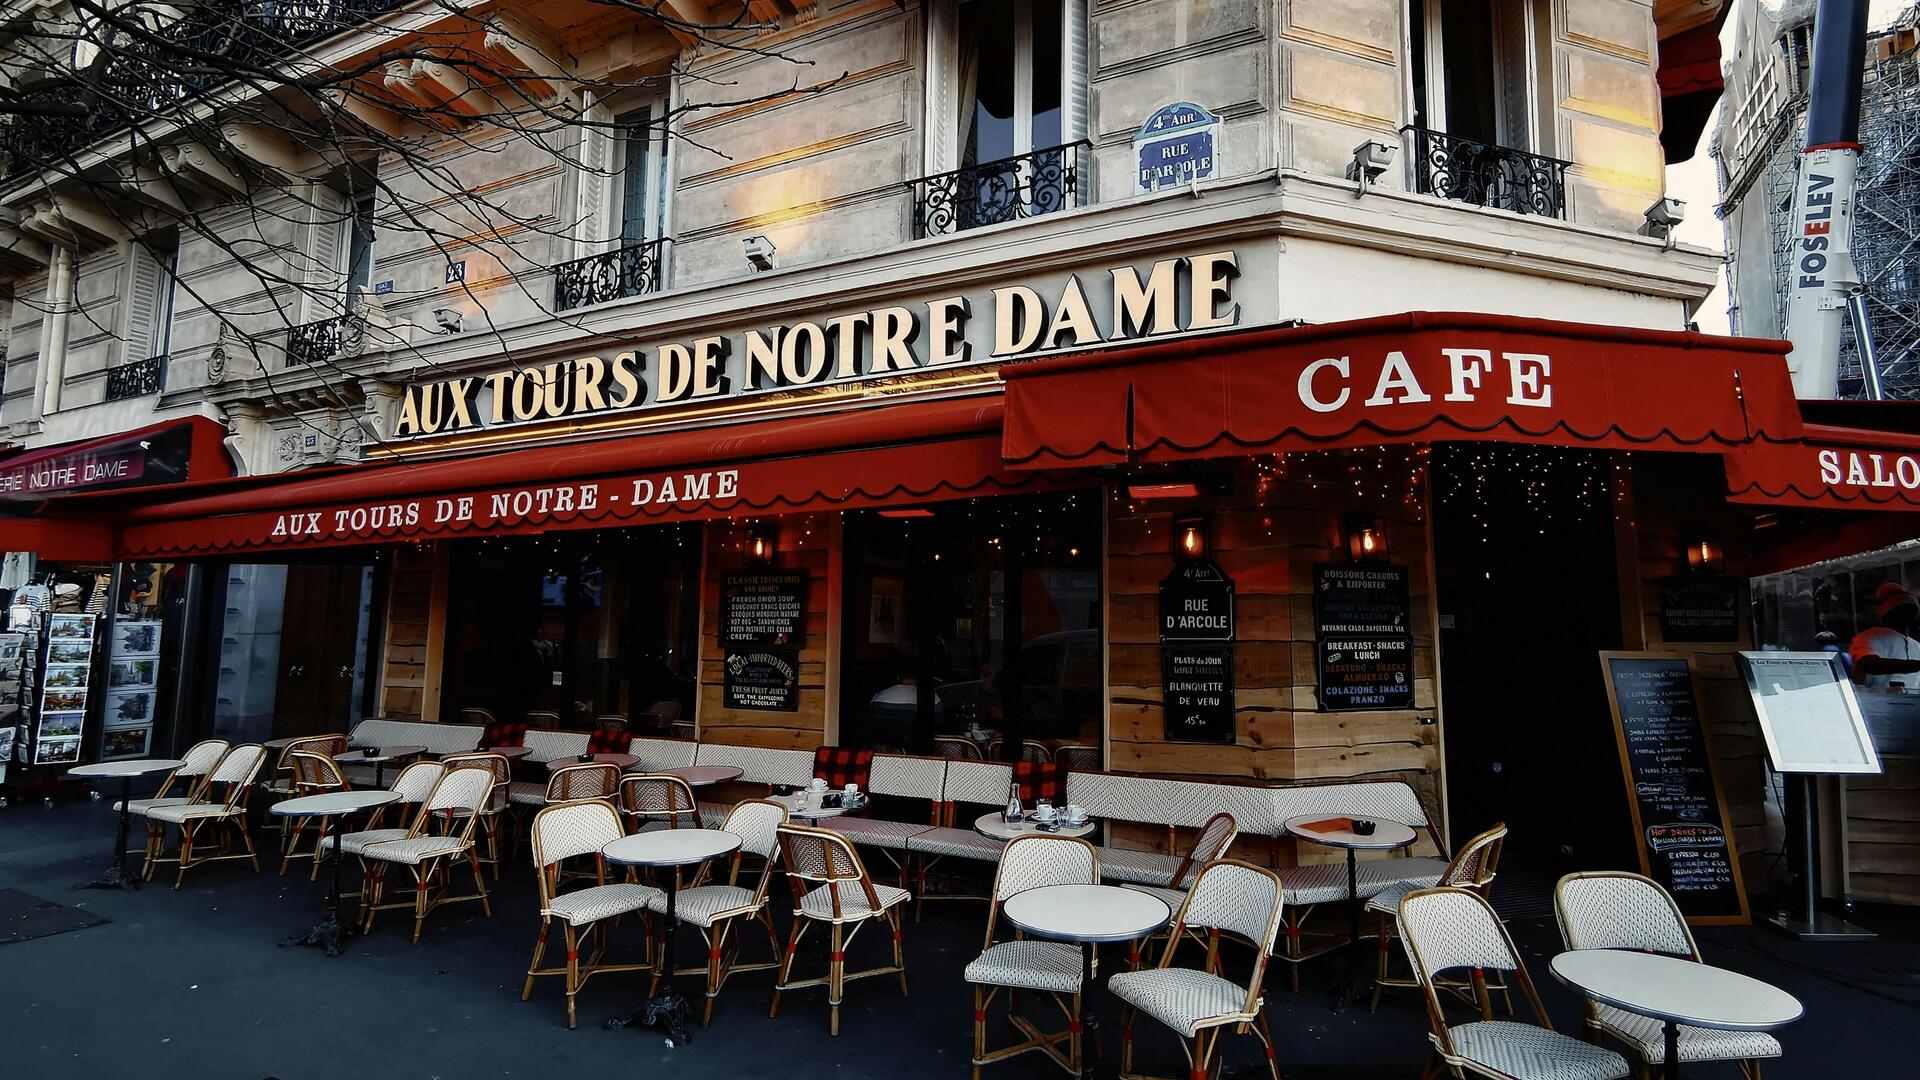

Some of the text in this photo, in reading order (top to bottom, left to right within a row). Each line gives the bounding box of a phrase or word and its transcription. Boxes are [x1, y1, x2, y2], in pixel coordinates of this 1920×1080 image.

[1162, 143, 1189, 159] RUE
[1799, 173, 1834, 288] FOSELEV
[393, 251, 1240, 436] AUX TOURS DE NOTRE DAME
[1297, 347, 1553, 413] CAFE
[29, 467, 76, 489] NOTRE
[84, 460, 129, 482] DAME
[1818, 449, 1920, 490] SALO
[272, 512, 322, 537] AUX
[335, 502, 420, 532] TOURS
[435, 496, 474, 524] DE
[489, 484, 599, 519] NOTRE
[631, 470, 740, 507] DAME
[1324, 570, 1400, 581] BOISSONS CHAUDES
[1337, 580, 1387, 589] A EMPORTER
[1184, 598, 1209, 612] RUE
[1166, 615, 1228, 629] D'ARCOLE
[1395, 625, 1405, 633] VIA
[1174, 656, 1223, 665] PLATS du JOUR
[1354, 651, 1380, 660] LUNCH
[1325, 662, 1367, 672] DESAYUNO
[1376, 662, 1408, 672] SNACKS
[1344, 672, 1390, 682] ALMUERZO
[732, 686, 751, 694] FRESH
[751, 687, 768, 695] FRUIT
[1169, 681, 1224, 693] BLANQUETTE
[1179, 696, 1221, 706] DE VEAU
[1350, 695, 1385, 704] PRANZO
[1651, 828, 1665, 837] HOT
[1671, 829, 1696, 837] DRINKS
